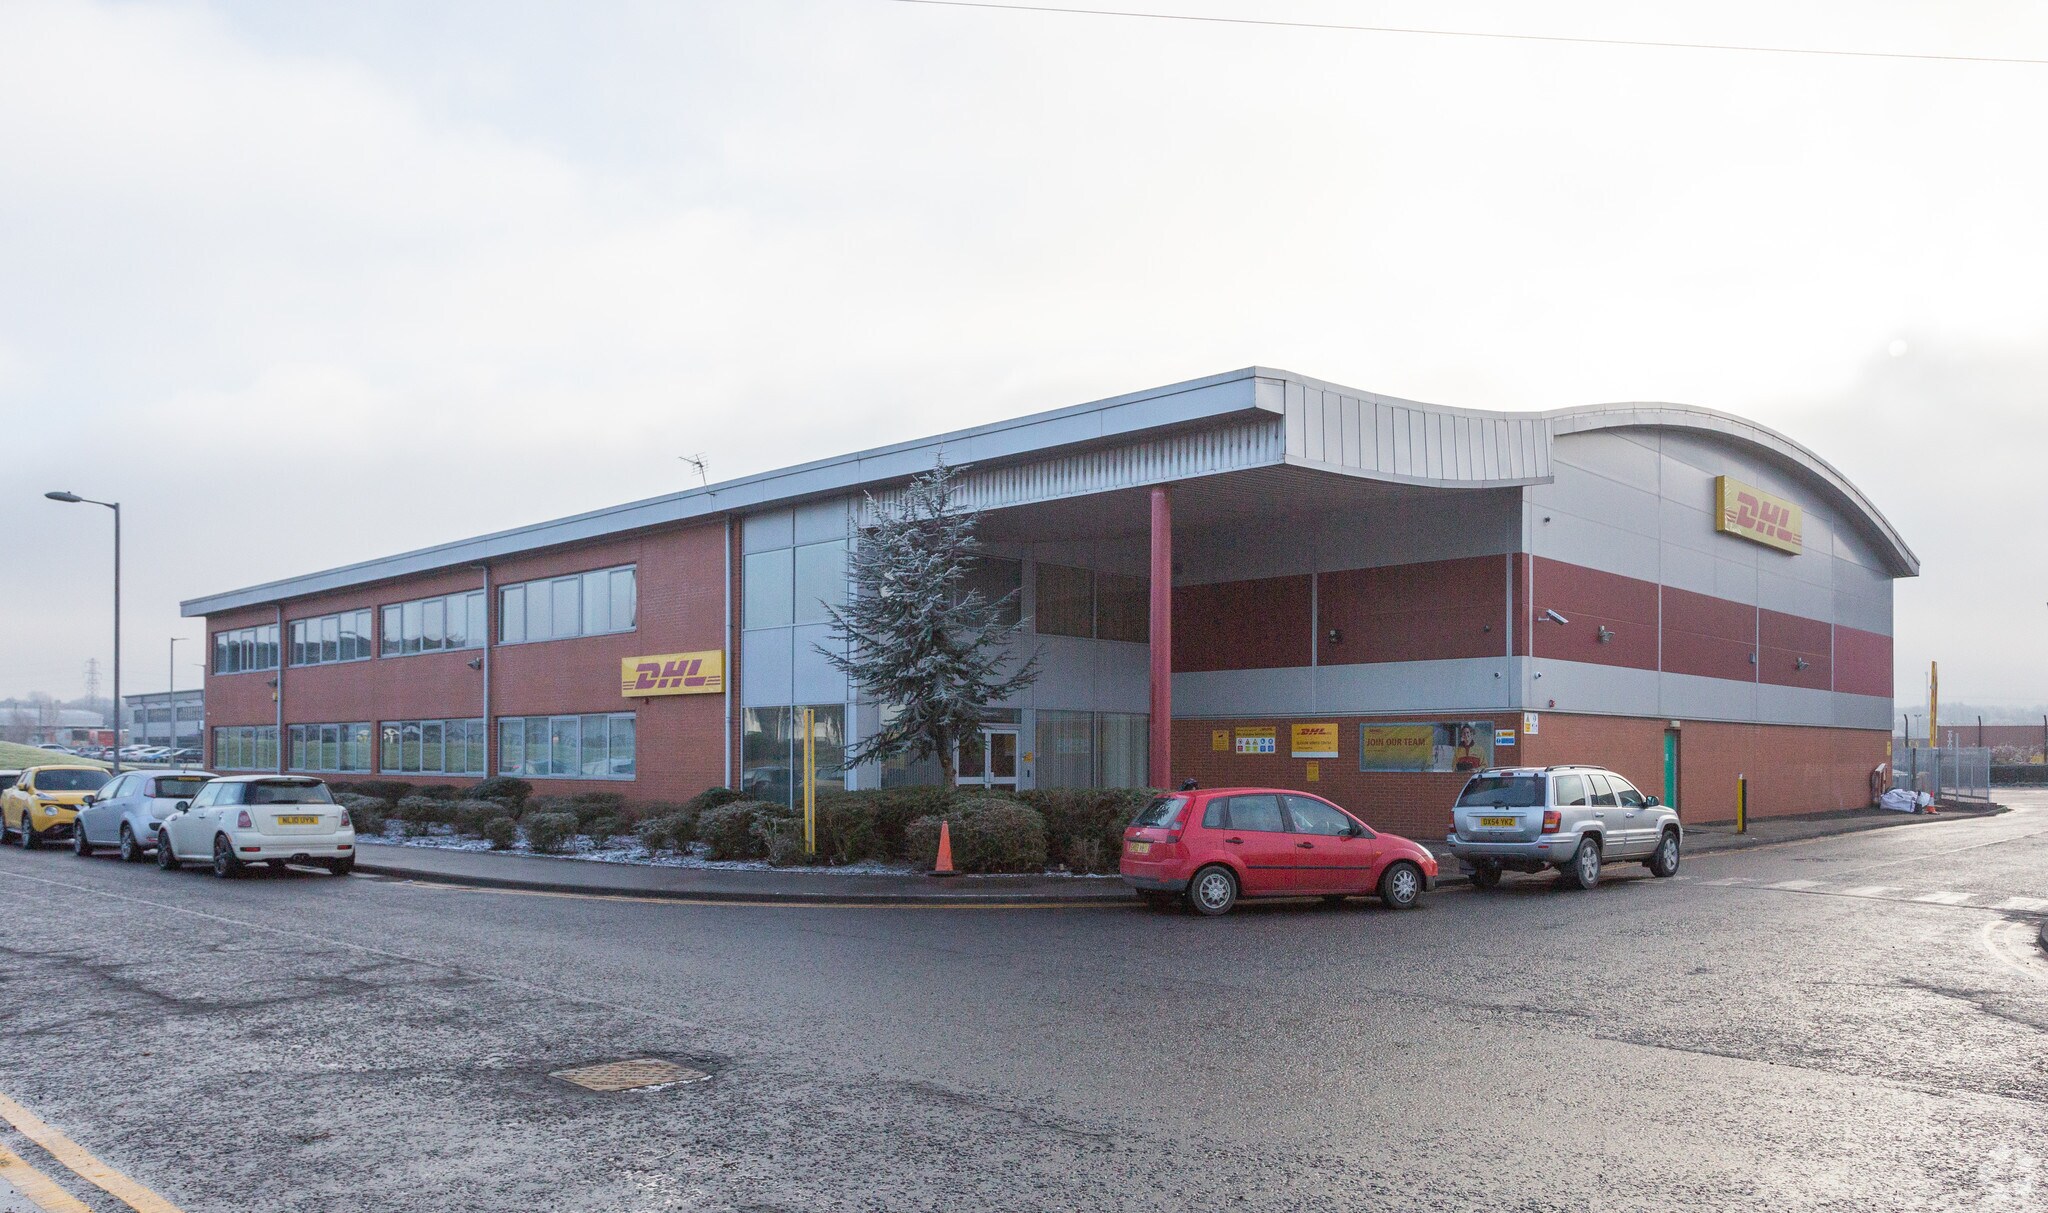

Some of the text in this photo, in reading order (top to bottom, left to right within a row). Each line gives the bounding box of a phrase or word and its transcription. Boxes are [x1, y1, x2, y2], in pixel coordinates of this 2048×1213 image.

[1736, 491, 1793, 543] DHL
[634, 659, 707, 690] DHL
[1300, 728, 1326, 736] DHL
[1366, 737, 1426, 747] JOIN OUR TEAM
